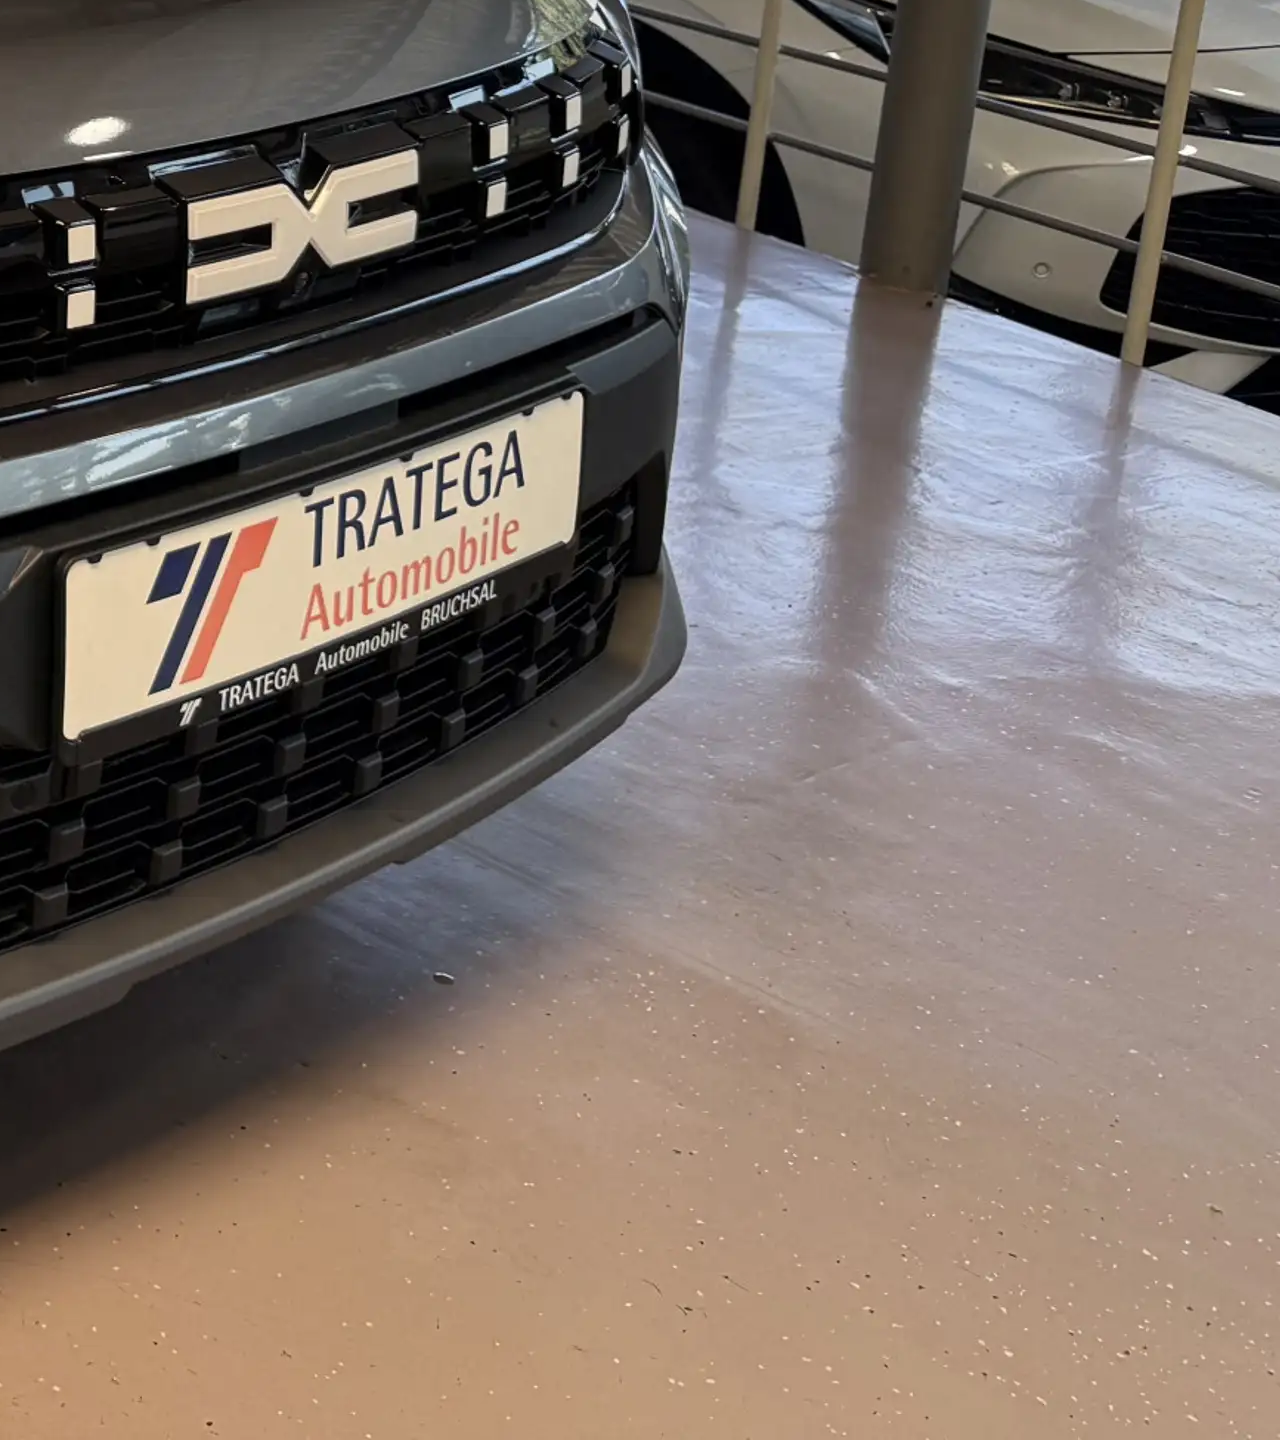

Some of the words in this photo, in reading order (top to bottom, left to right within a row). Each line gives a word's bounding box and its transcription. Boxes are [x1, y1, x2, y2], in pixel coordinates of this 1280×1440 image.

[303, 429, 526, 568] TRATEGA
[299, 512, 521, 640] Automobile
[218, 662, 300, 711] TRATEGA
[314, 621, 409, 675] Automobile
[420, 579, 497, 631] BRUCHSAL
